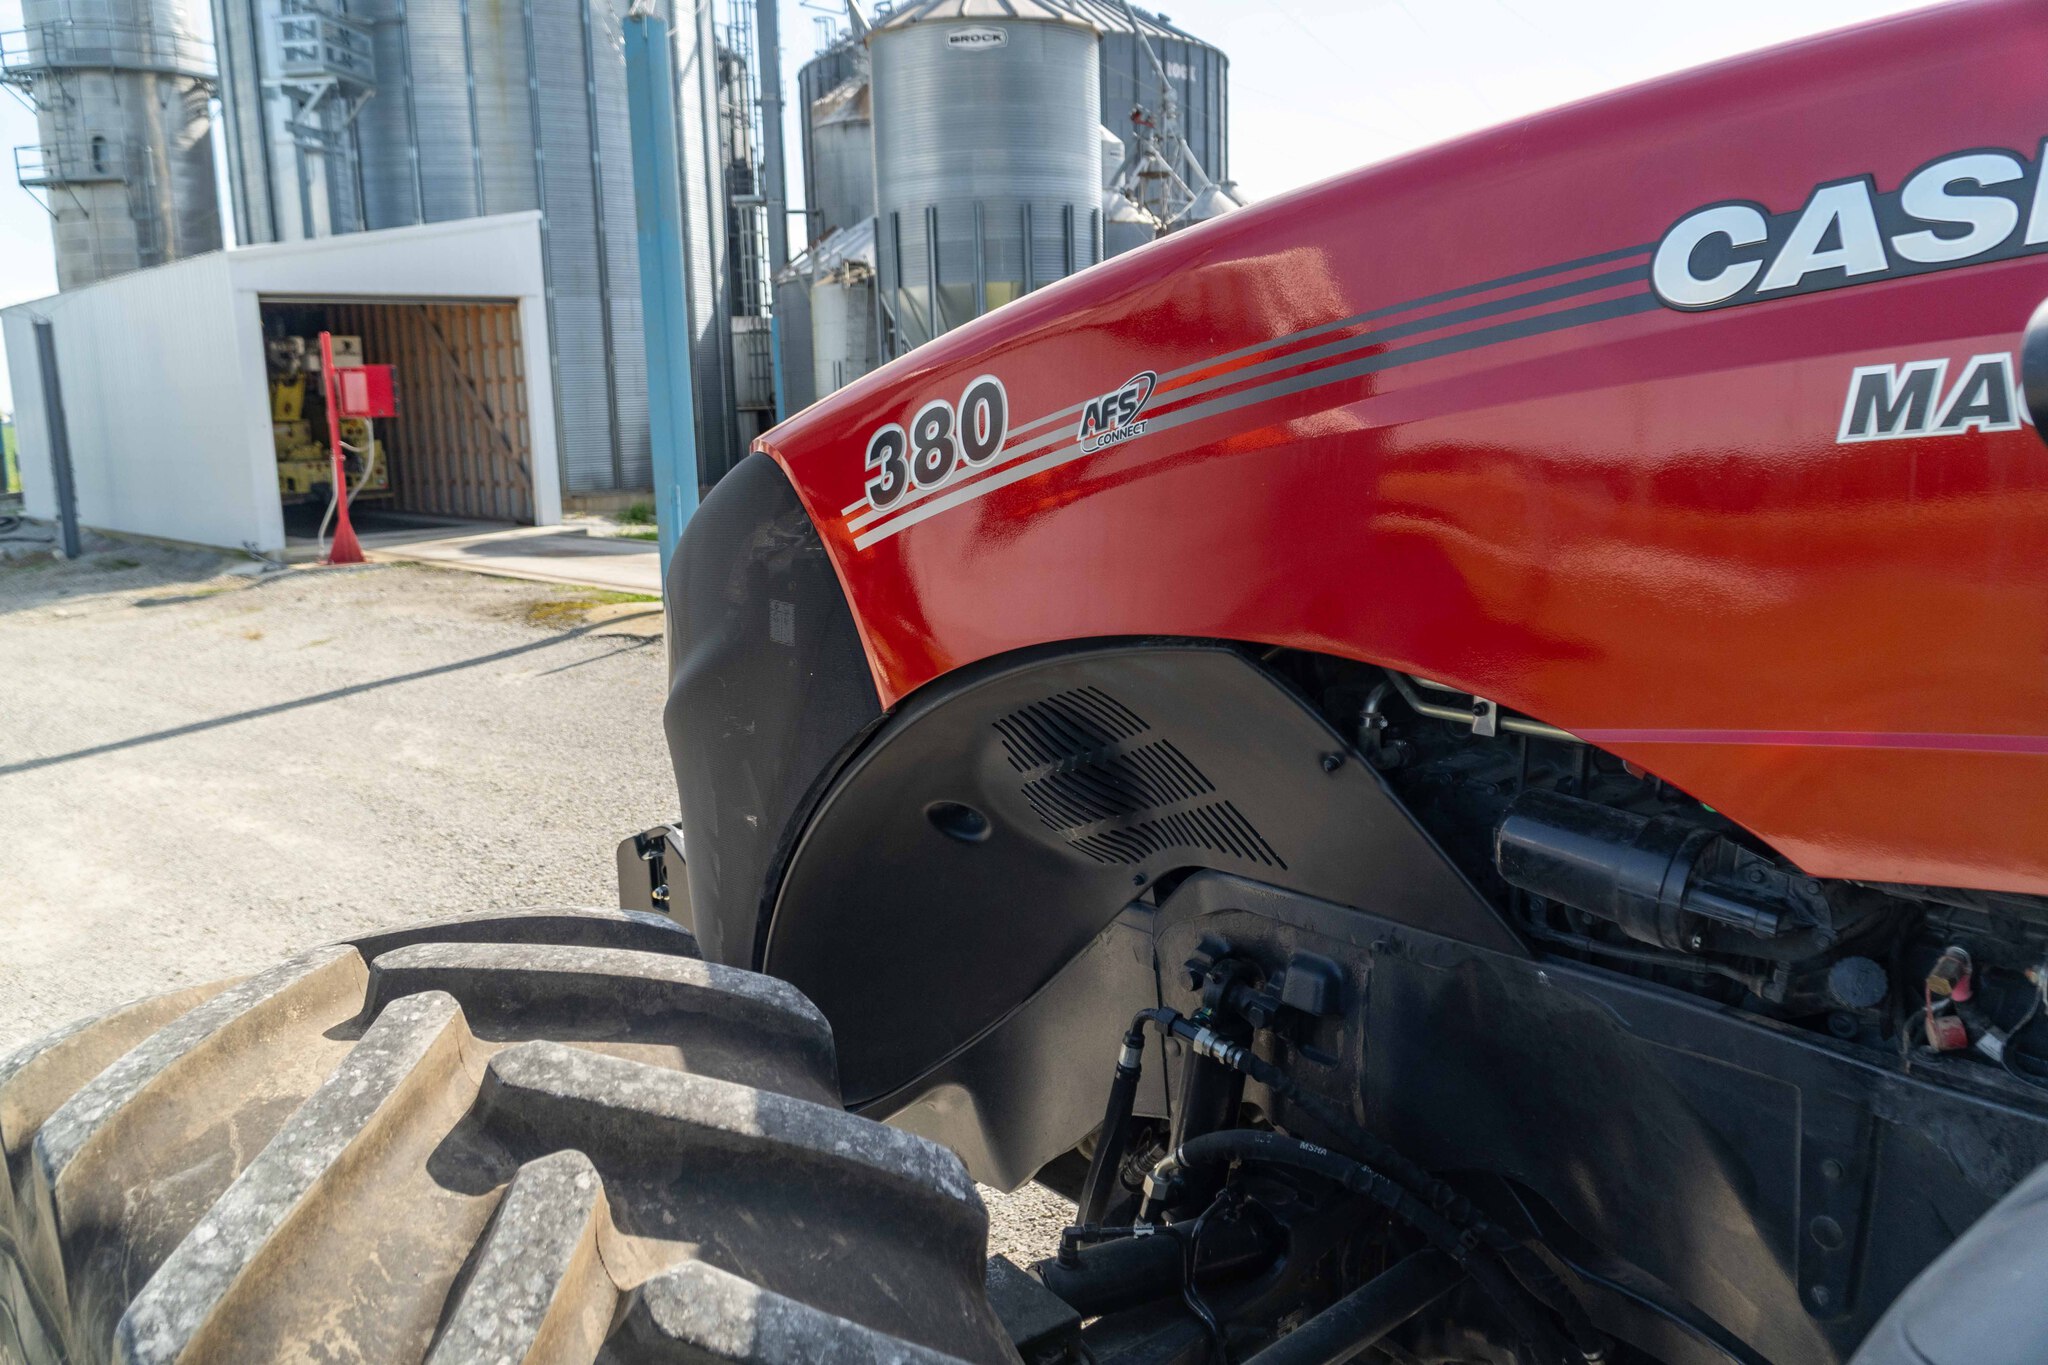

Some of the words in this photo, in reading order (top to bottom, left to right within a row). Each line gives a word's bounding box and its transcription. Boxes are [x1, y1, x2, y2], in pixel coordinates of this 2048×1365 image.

[950, 34, 1002, 43] BROCK
[1652, 141, 2048, 306] CAS
[1078, 384, 1139, 439] AFS
[1098, 420, 1147, 446] CONNECT
[1836, 352, 2034, 443] MA
[865, 374, 1008, 512] 380
